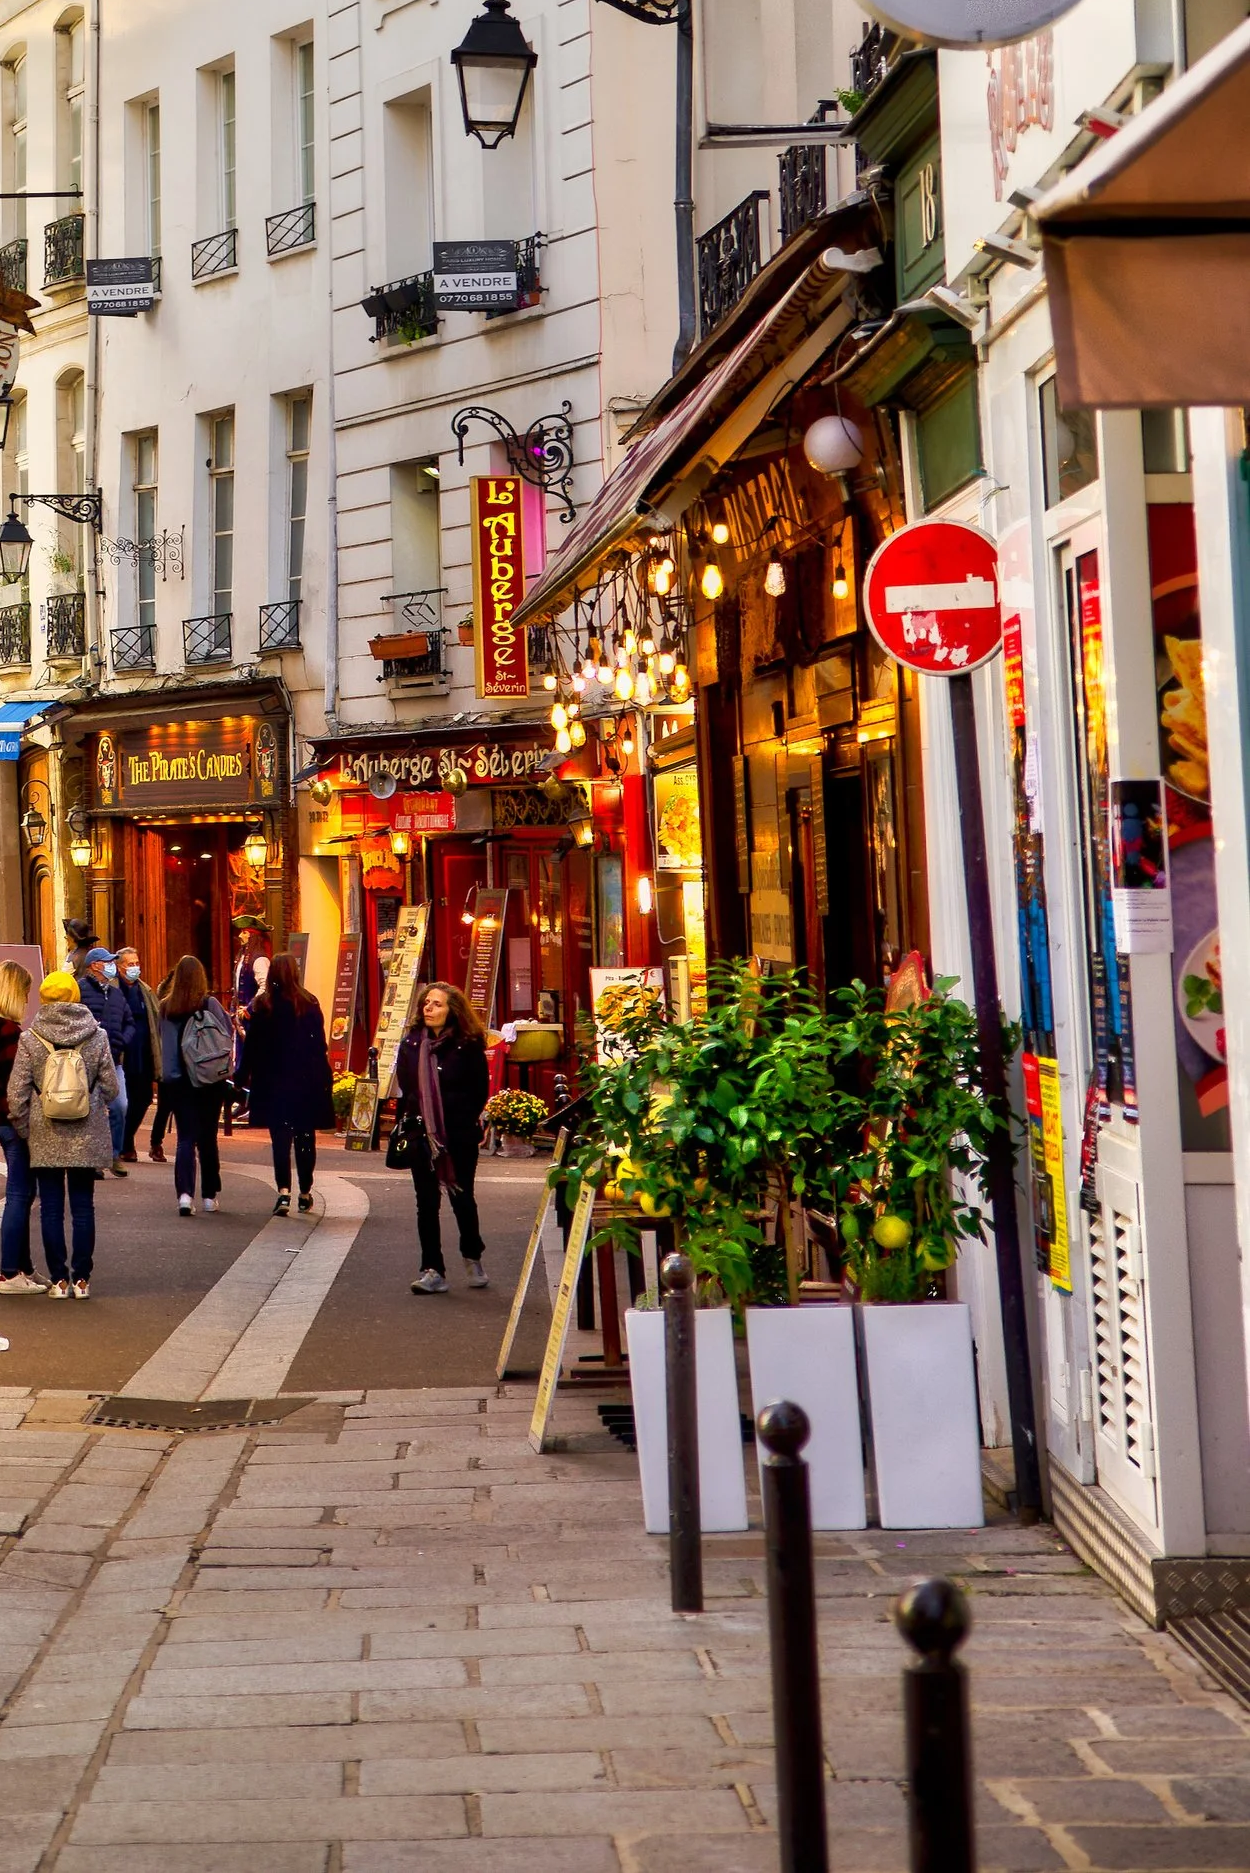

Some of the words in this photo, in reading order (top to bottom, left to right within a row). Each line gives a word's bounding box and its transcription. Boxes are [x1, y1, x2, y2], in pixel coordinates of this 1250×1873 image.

[919, 163, 936, 248] 18
[102, 287, 149, 297] VENDRE
[440, 279, 449, 288] A
[452, 277, 512, 287] VENDRE
[485, 681, 526, 694] Séverin
[128, 755, 150, 786] THE
[148, 751, 196, 782] PIRATE'S
[197, 749, 243, 782] CANDIES
[339, 752, 433, 786] L'Auberge
